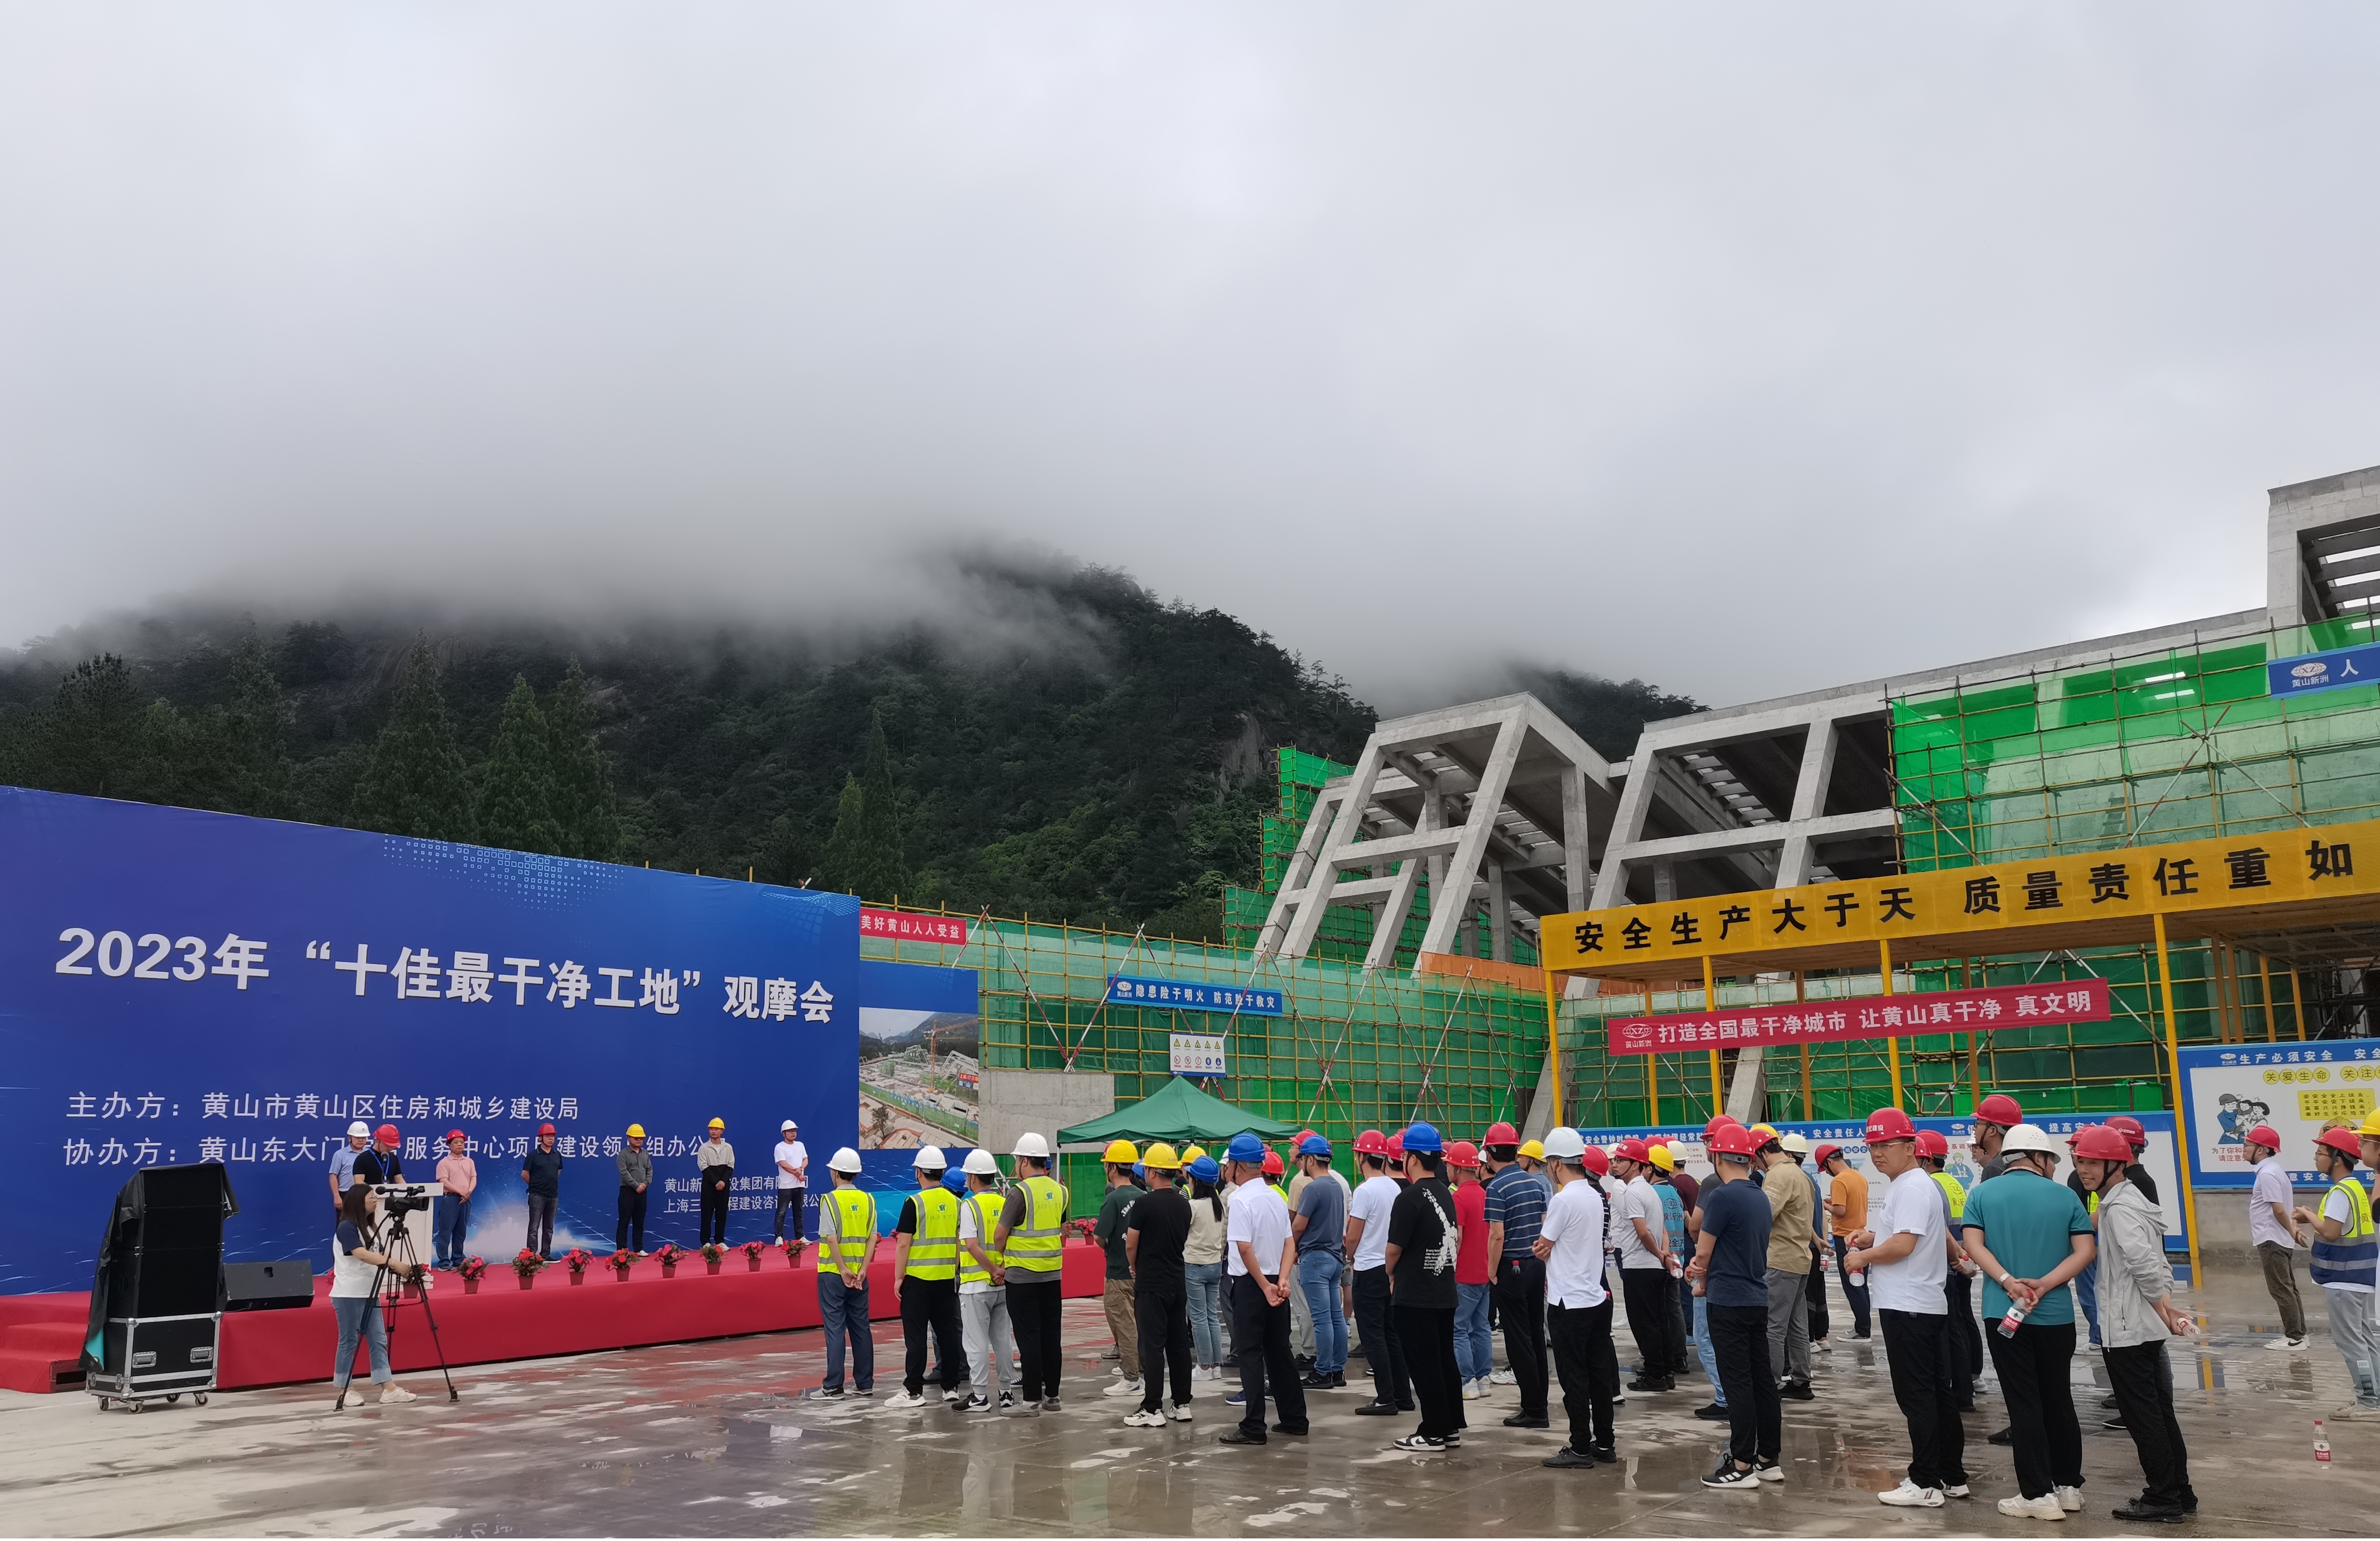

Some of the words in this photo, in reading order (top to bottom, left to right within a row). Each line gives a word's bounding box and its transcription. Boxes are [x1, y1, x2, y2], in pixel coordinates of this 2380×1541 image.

[2292, 675, 2329, 688] 黄山新洲
[1575, 886, 1917, 954] 安全生产大于天
[1964, 839, 2353, 914] 质量责任重如
[861, 914, 960, 939] 美好黄山人人受益
[1136, 984, 1204, 1003] 隐患险于明火
[1658, 1010, 1846, 1044] 打造全国最干净城市
[1859, 998, 2002, 1029] 让黄山真干净
[2015, 990, 2091, 1017] 真文明
[1625, 1039, 1652, 1049] 黄山新洲
[2240, 1050, 2333, 1065] 生产必须安全
[2266, 1070, 2327, 1082] 关爱生命
[2344, 1068, 2380, 1078] 关注
[66, 1091, 578, 1120] 主办方：黄山市黄山区住房和城乡建设局
